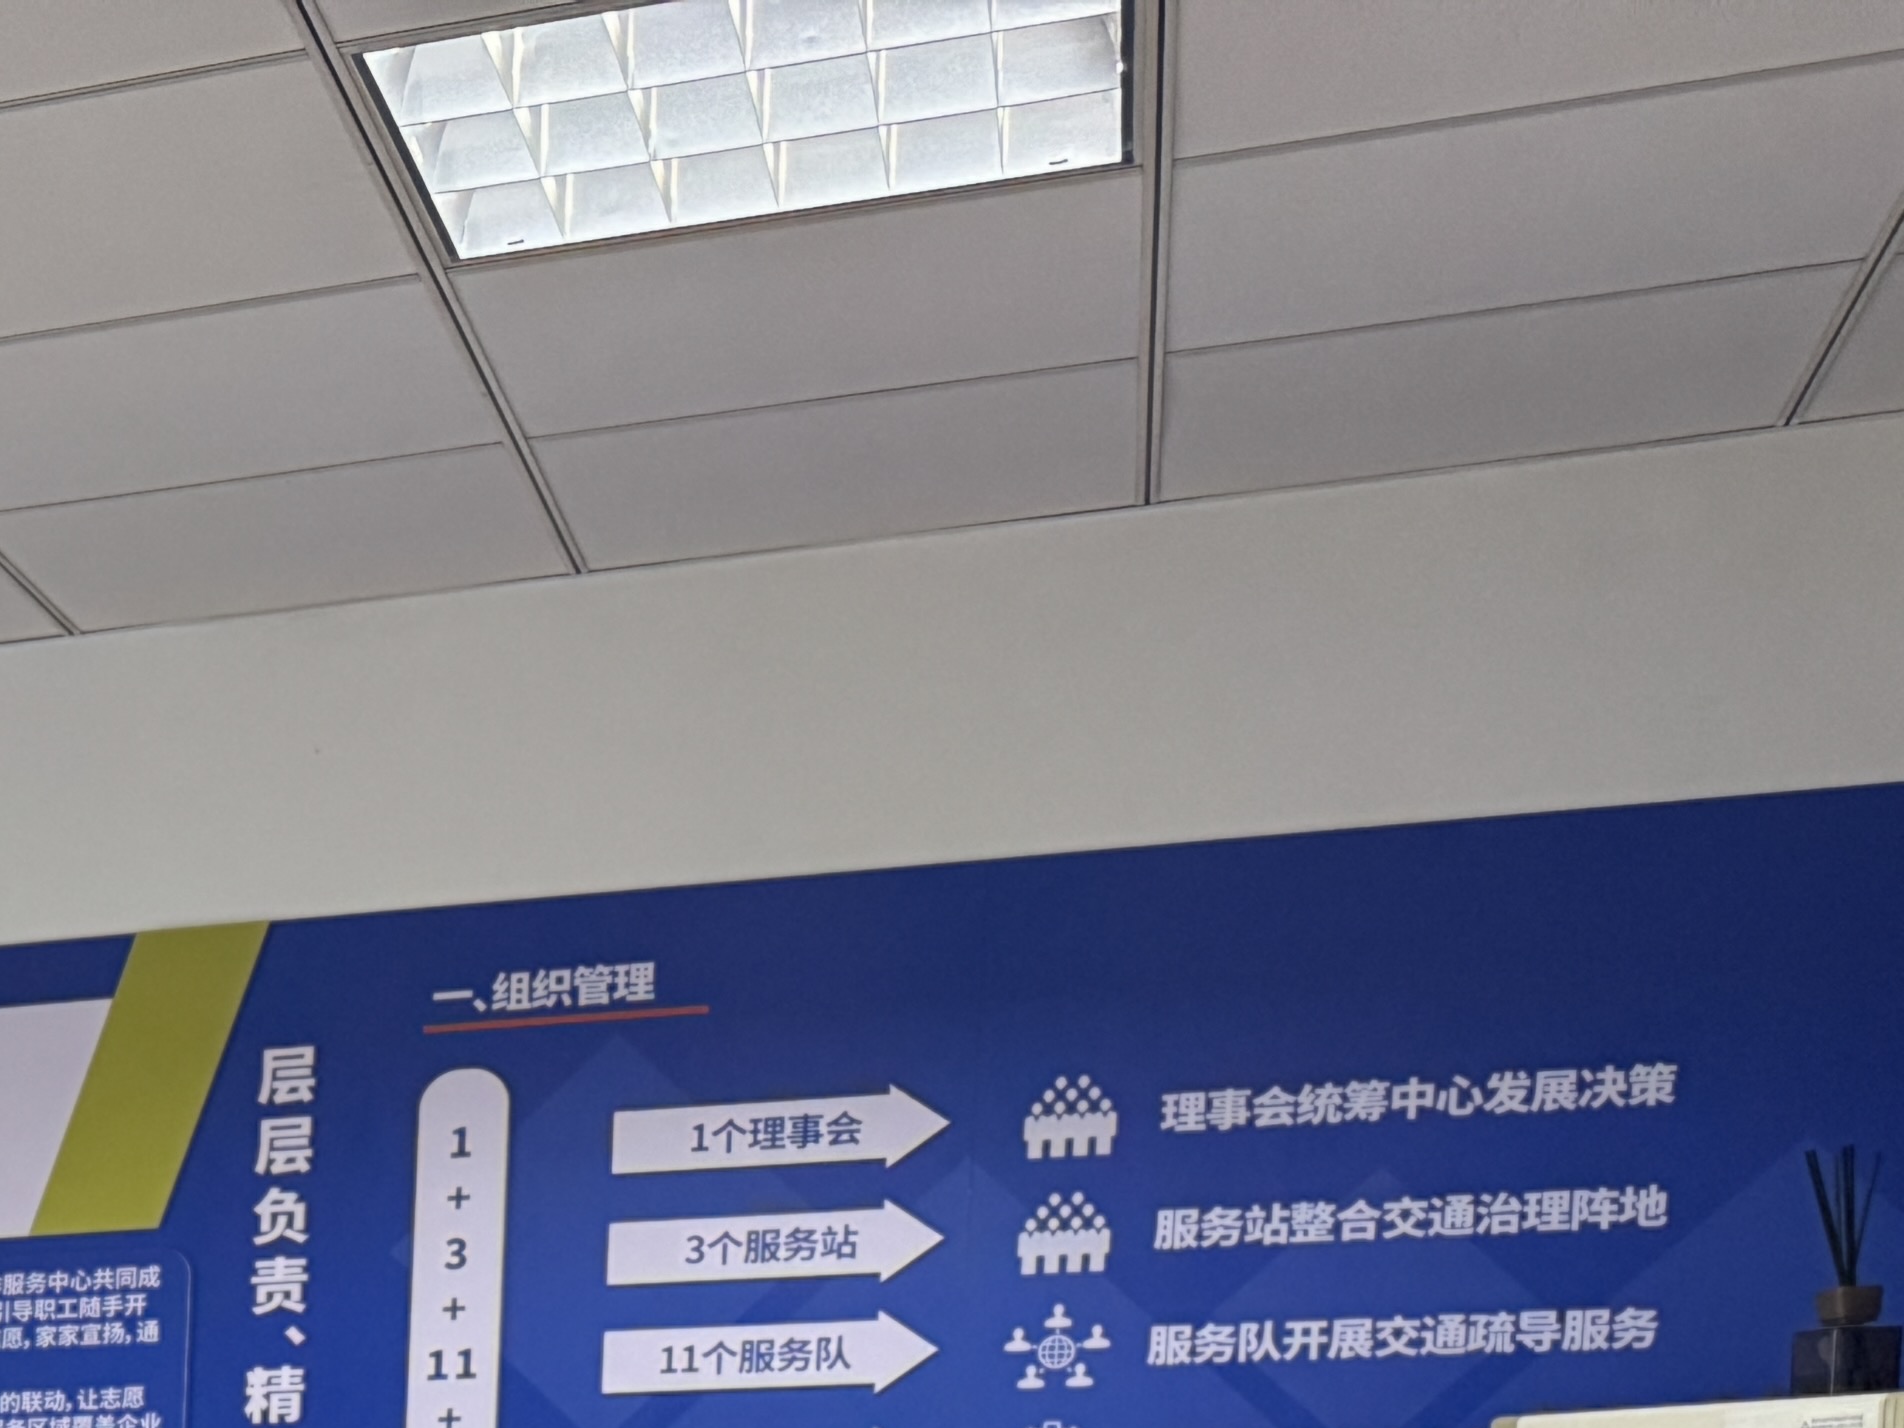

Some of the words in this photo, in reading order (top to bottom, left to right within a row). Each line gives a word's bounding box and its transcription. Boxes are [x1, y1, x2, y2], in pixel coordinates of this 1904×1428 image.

[433, 961, 657, 1014] 一、组织管理
[1159, 1061, 1679, 1134] 理事会统筹中心发展决策
[449, 1126, 472, 1158] 1
[690, 1111, 864, 1153] 1个理事会
[1153, 1184, 1669, 1251] 服务站整合交通治理阵地
[444, 1238, 468, 1270] 3
[684, 1225, 859, 1266] 3个服务站
[658, 1335, 852, 1376] 11个服务队
[1147, 1306, 1659, 1367] 服务队开展交通疏导服务
[426, 1348, 478, 1382] 11
